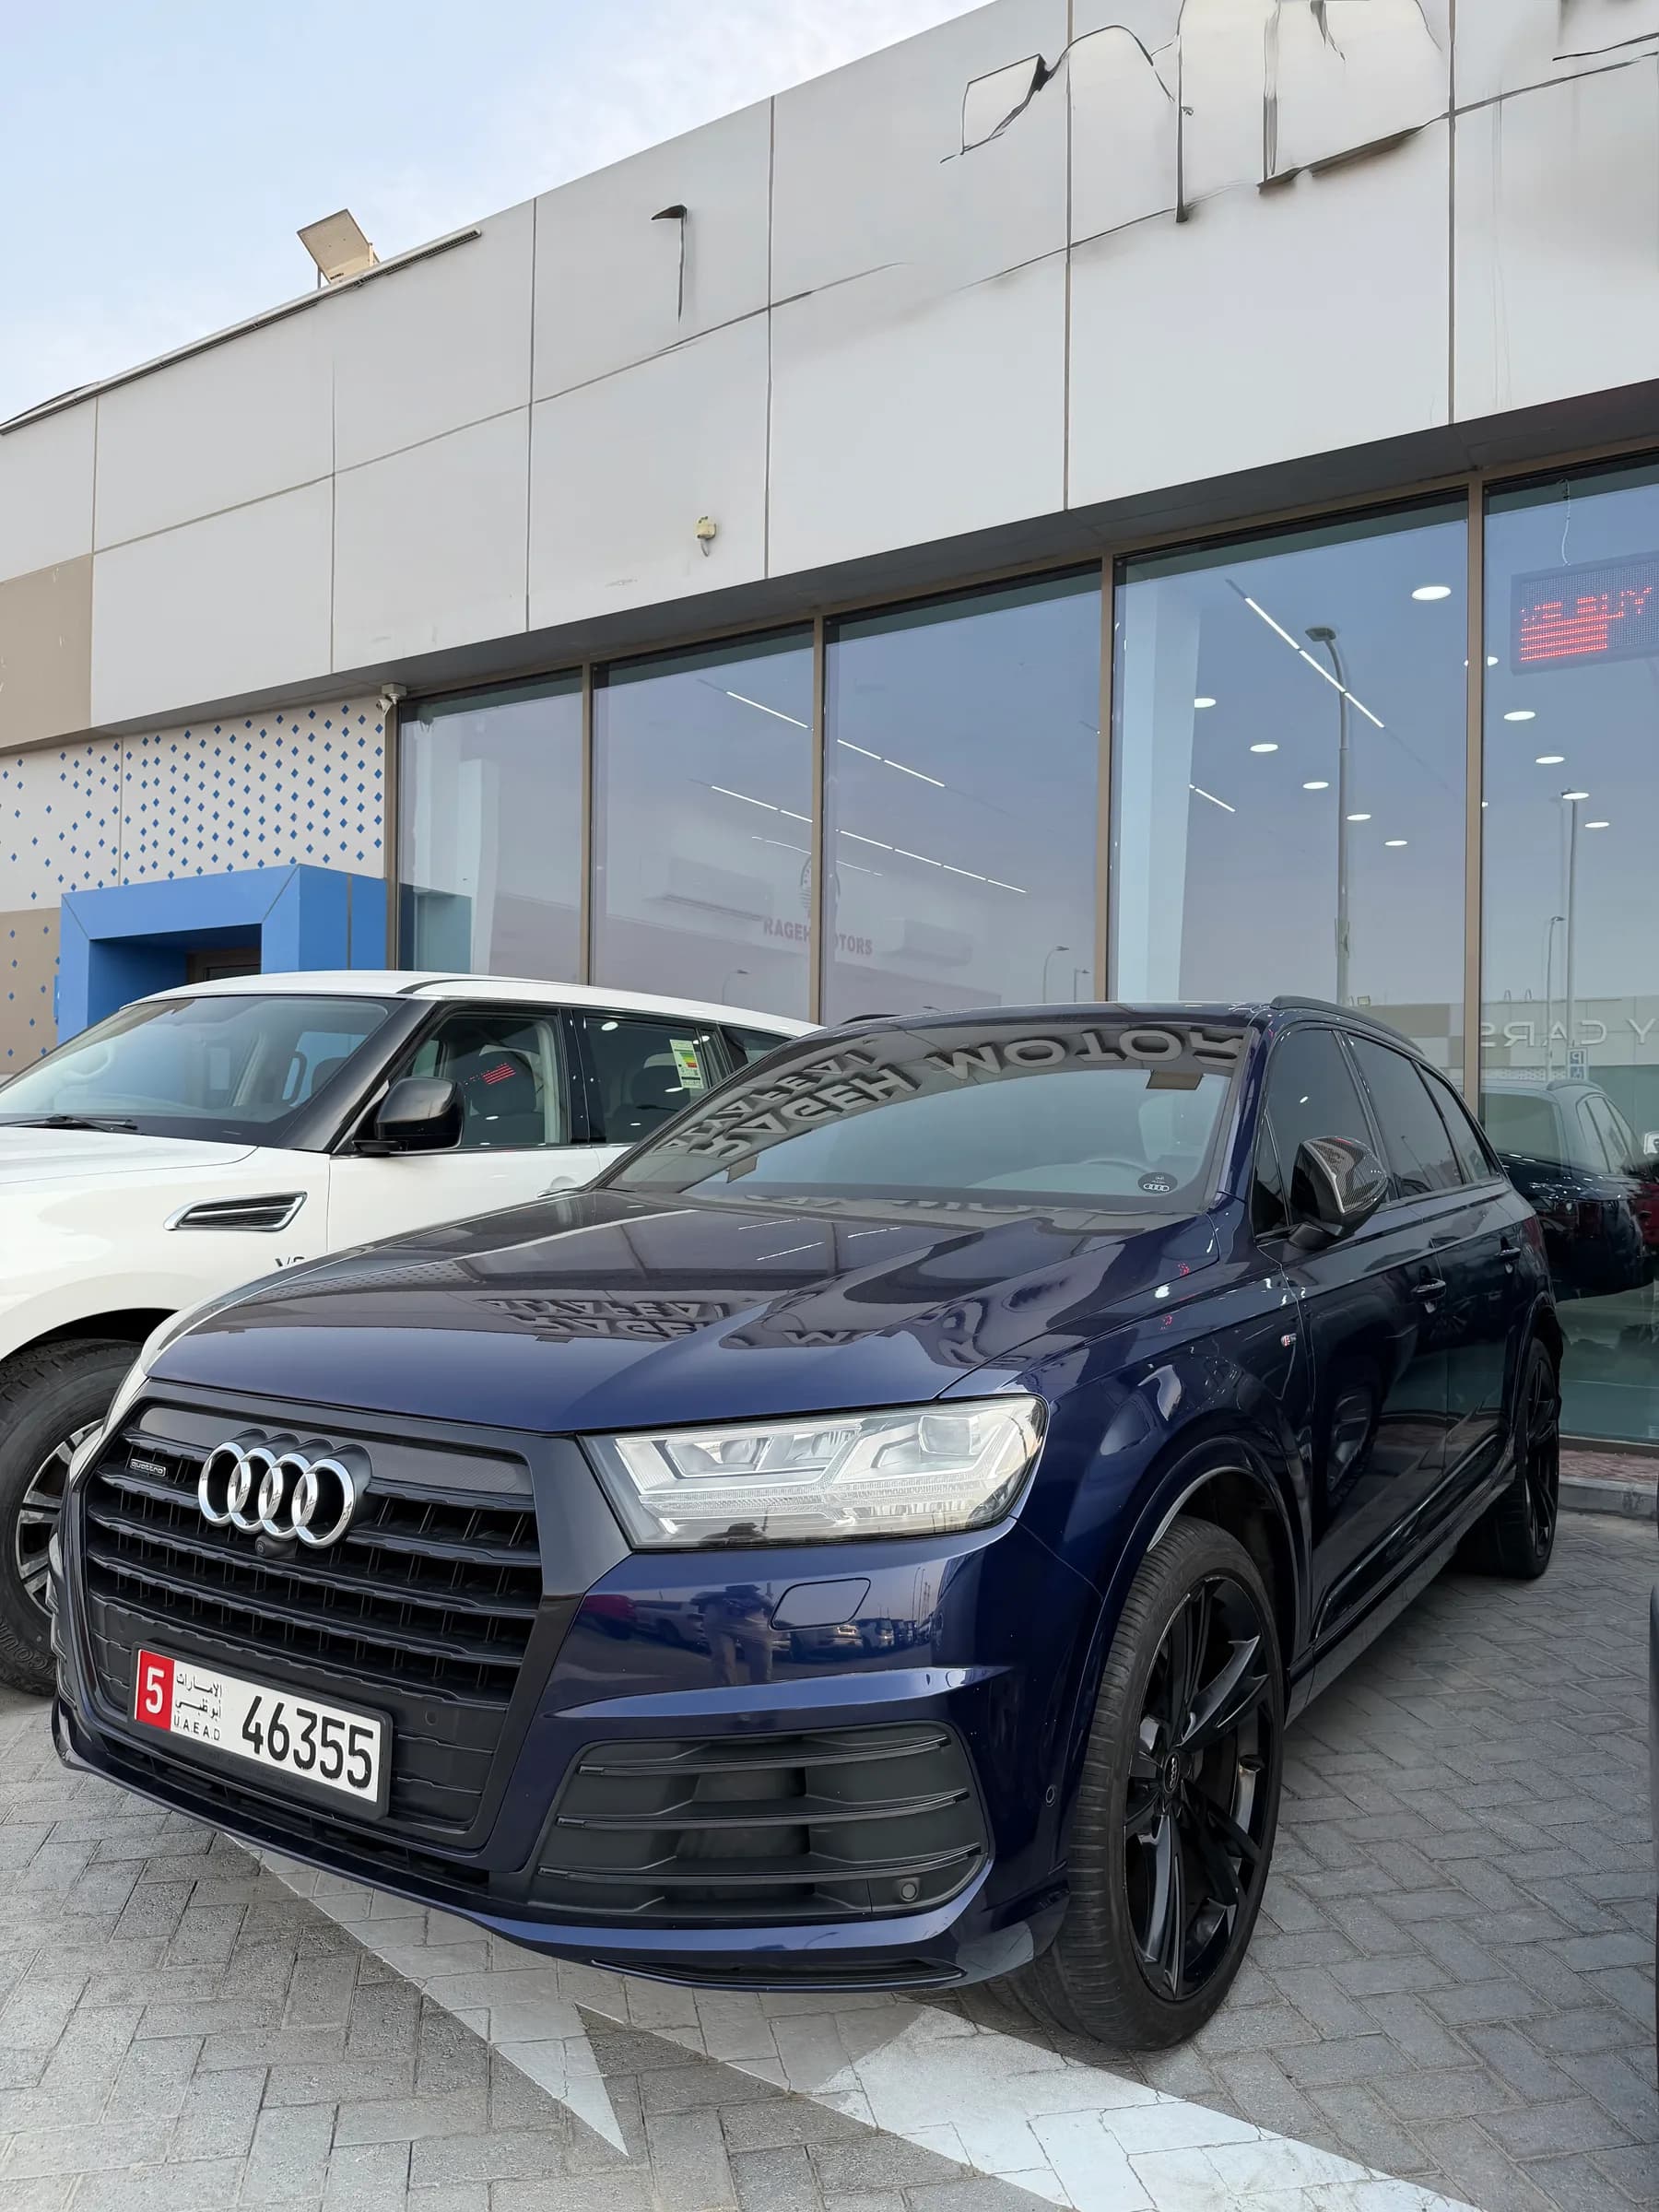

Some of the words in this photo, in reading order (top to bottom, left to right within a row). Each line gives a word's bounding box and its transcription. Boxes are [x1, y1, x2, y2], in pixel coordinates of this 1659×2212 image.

[834, 933, 873, 956] TORS
[275, 1256, 305, 1267] V
[145, 1666, 165, 1714] 5
[241, 1695, 374, 1789] 46355
